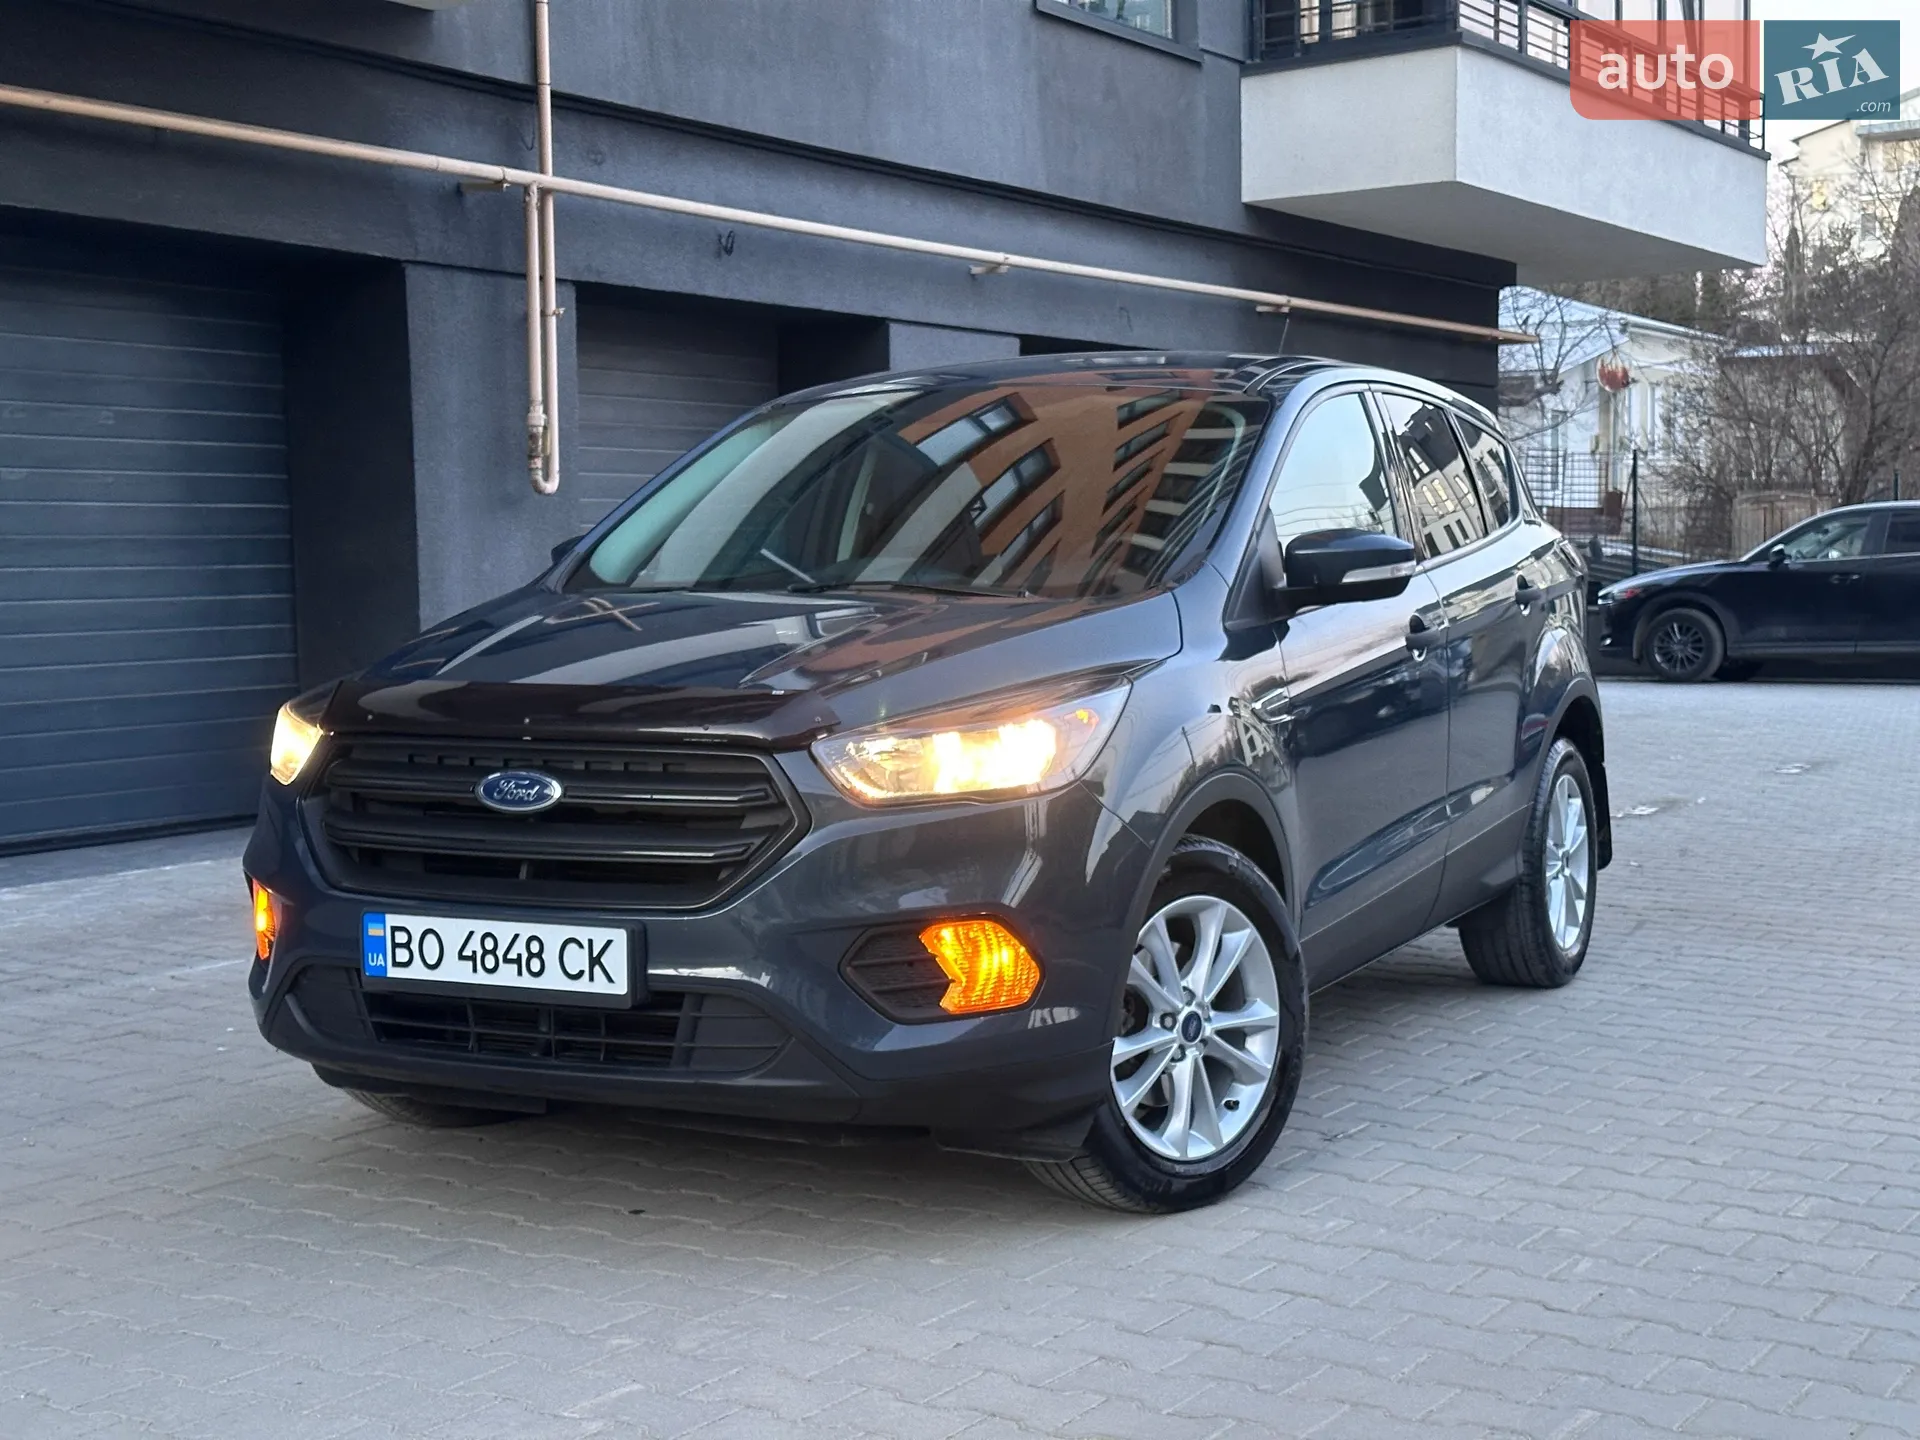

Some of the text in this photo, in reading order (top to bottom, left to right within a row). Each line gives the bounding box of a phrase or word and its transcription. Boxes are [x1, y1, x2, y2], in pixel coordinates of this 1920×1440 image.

[493, 780, 540, 802] Ford
[368, 952, 385, 967] UA
[390, 925, 616, 984] BO 4848 CK
